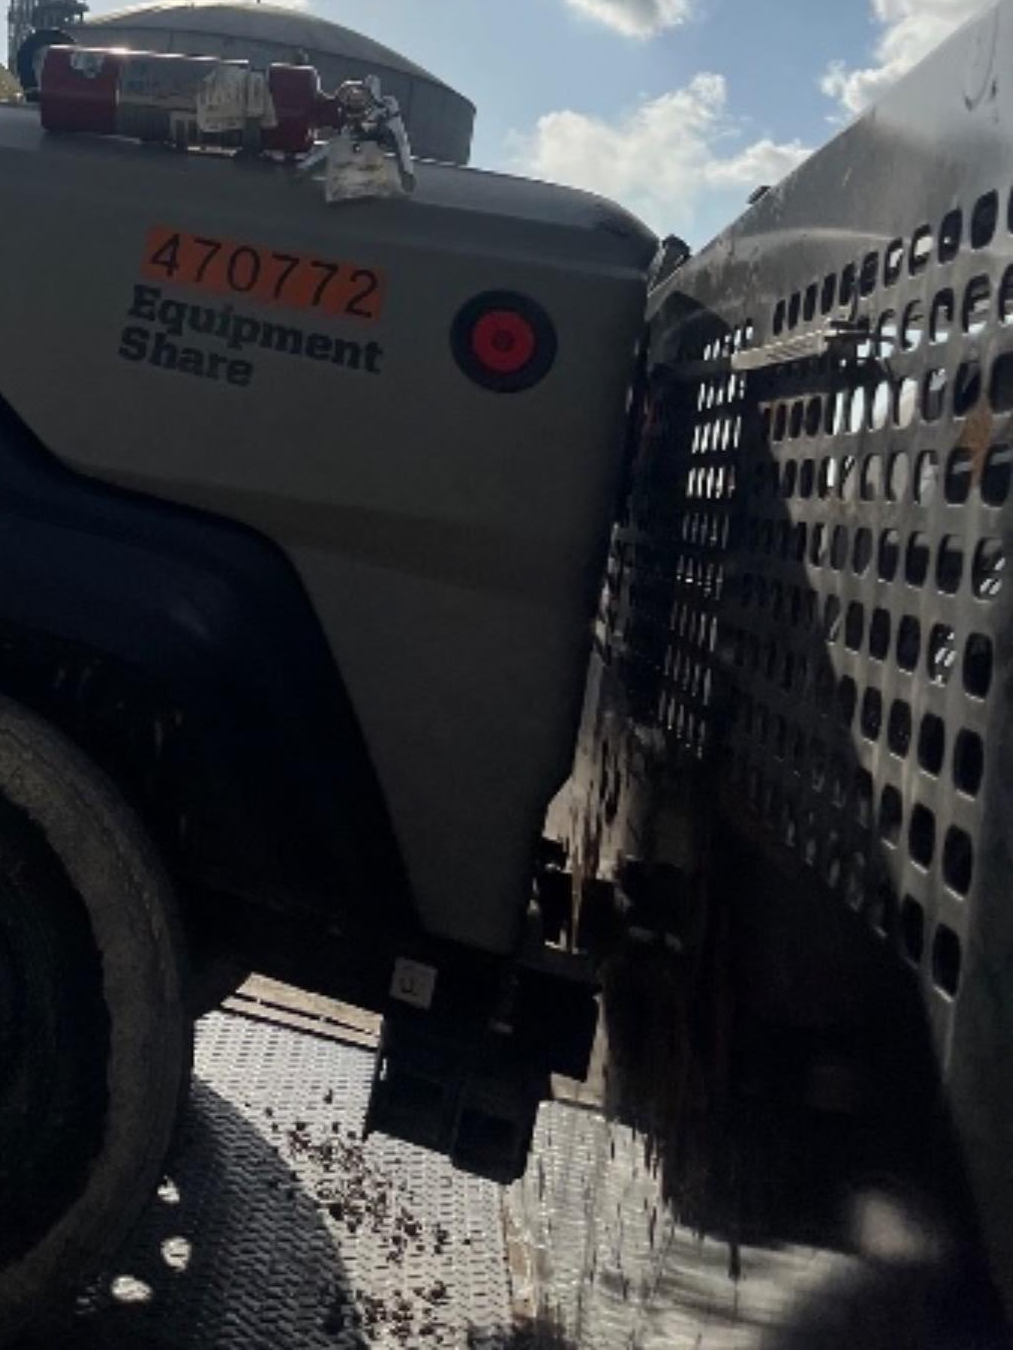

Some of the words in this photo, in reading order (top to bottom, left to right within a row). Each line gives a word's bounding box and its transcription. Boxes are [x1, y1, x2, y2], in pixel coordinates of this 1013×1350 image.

[150, 233, 379, 319] 470772
[118, 325, 254, 388] Share
[127, 284, 385, 376] Equipment
